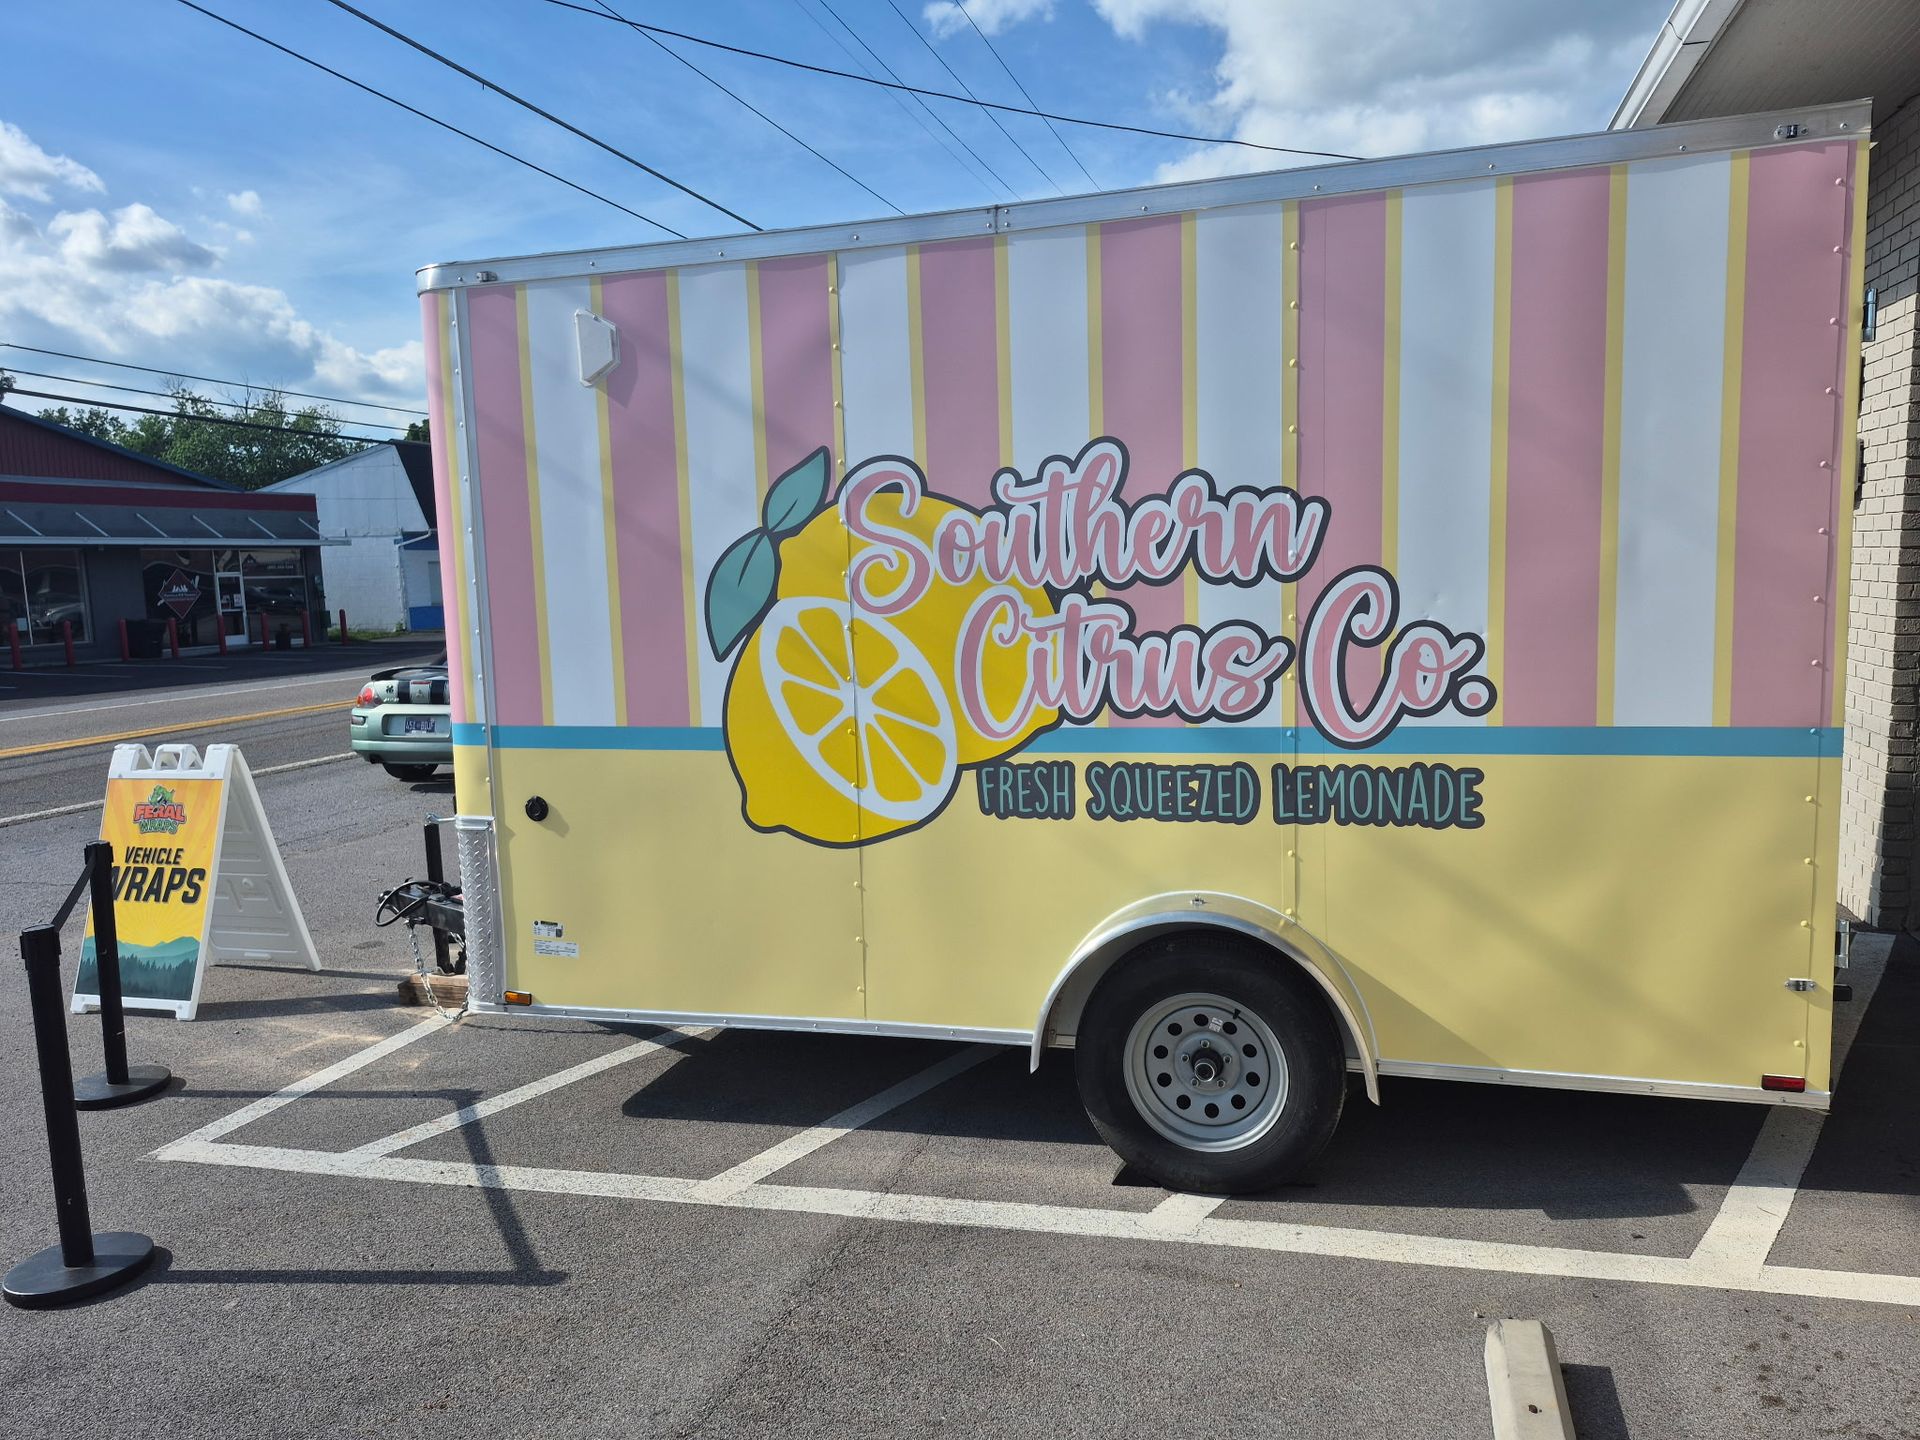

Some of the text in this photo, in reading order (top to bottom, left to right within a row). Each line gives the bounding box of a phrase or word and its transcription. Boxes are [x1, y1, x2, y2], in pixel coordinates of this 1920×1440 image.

[837, 440, 1327, 619] Southern
[953, 570, 1493, 744] Citrus Co.
[134, 804, 186, 822] FERAL
[980, 765, 1478, 823] FRESH SQUEEZED LEMONADE
[140, 819, 178, 834] WRAPS
[124, 846, 184, 865] VEHICLE
